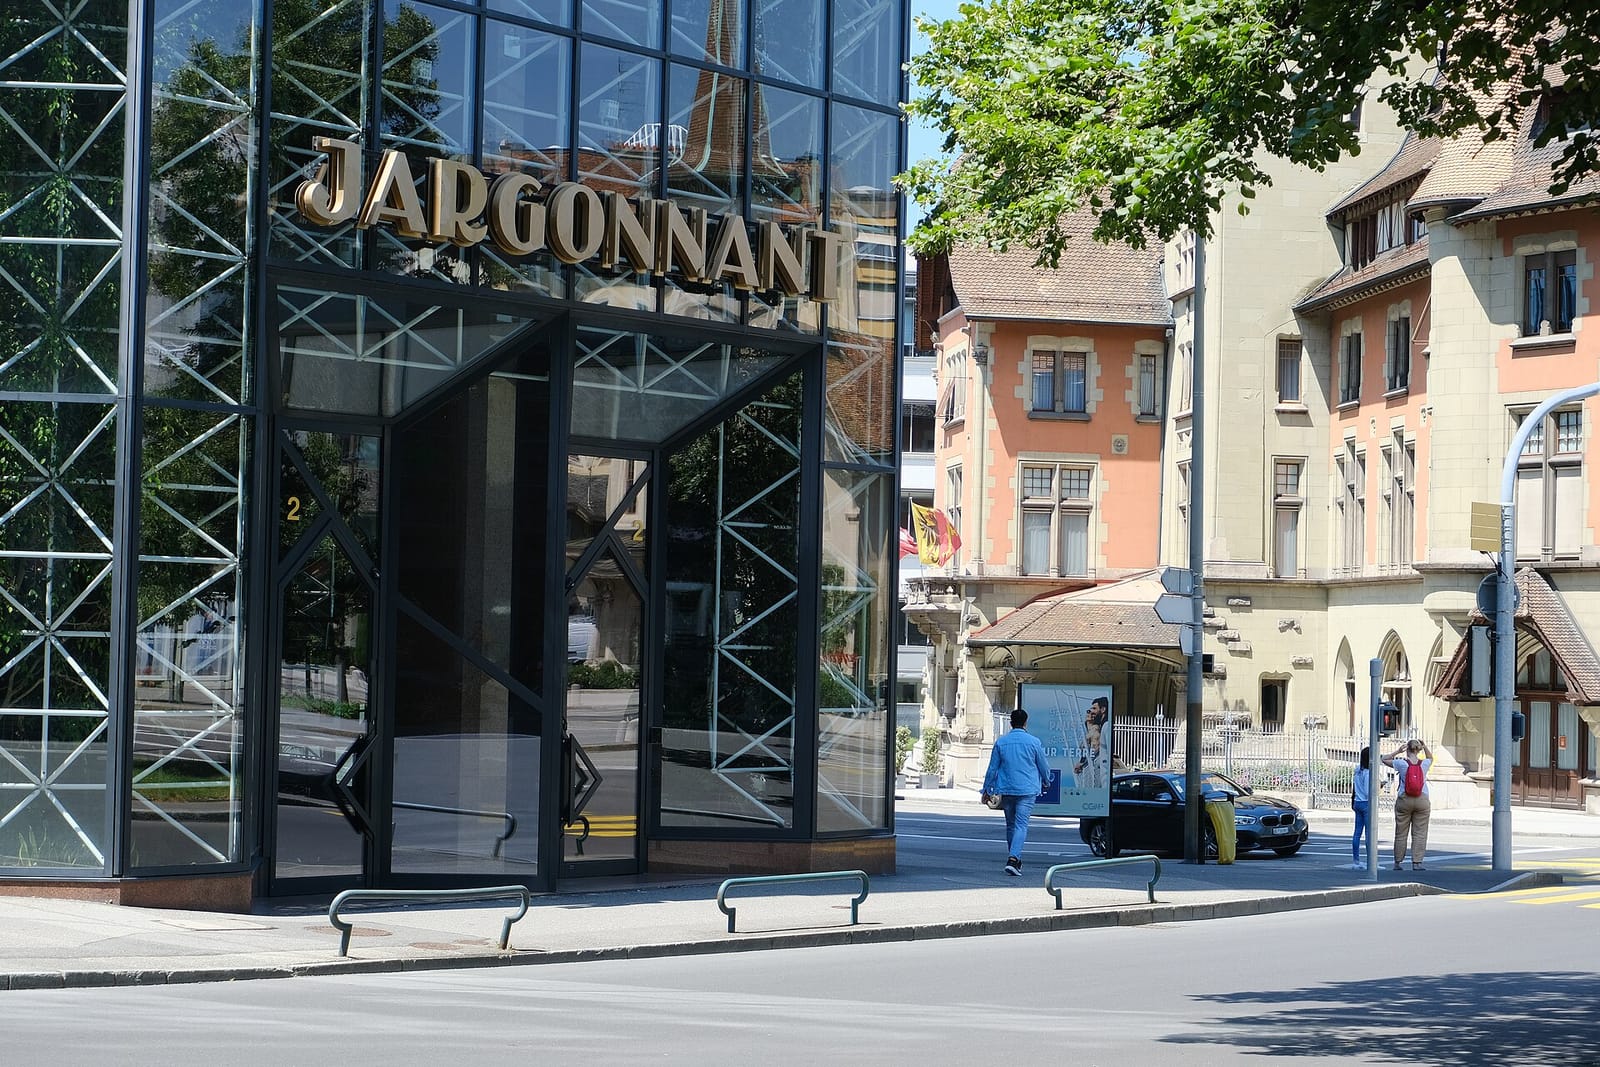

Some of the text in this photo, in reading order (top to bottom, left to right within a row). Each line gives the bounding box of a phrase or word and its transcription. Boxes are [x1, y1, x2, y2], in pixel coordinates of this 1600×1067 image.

[294, 136, 841, 302] JARGONNANT
[287, 496, 300, 521] 2
[632, 519, 644, 542] 2
[1062, 747, 1096, 758] TERRE
